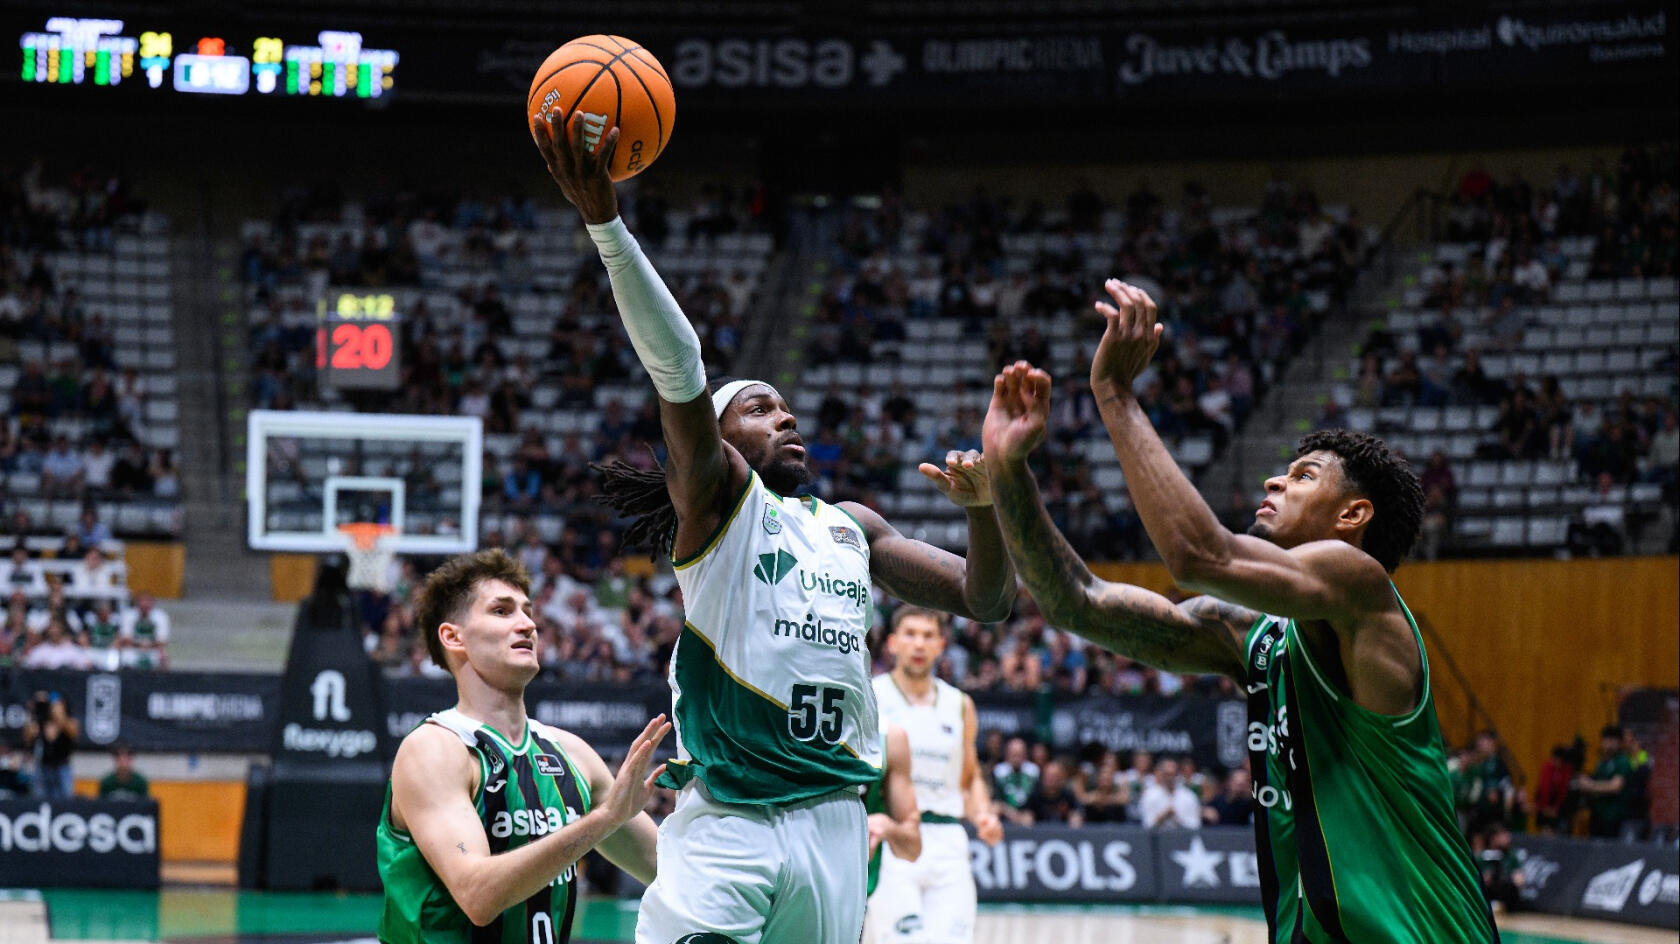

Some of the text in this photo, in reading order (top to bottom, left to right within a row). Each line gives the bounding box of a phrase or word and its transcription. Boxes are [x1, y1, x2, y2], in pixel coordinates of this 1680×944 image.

[673, 38, 853, 88] asisa
[331, 323, 393, 370] 20
[800, 569, 867, 607] Unicaja
[788, 683, 846, 744] 55
[492, 806, 563, 838] asisa
